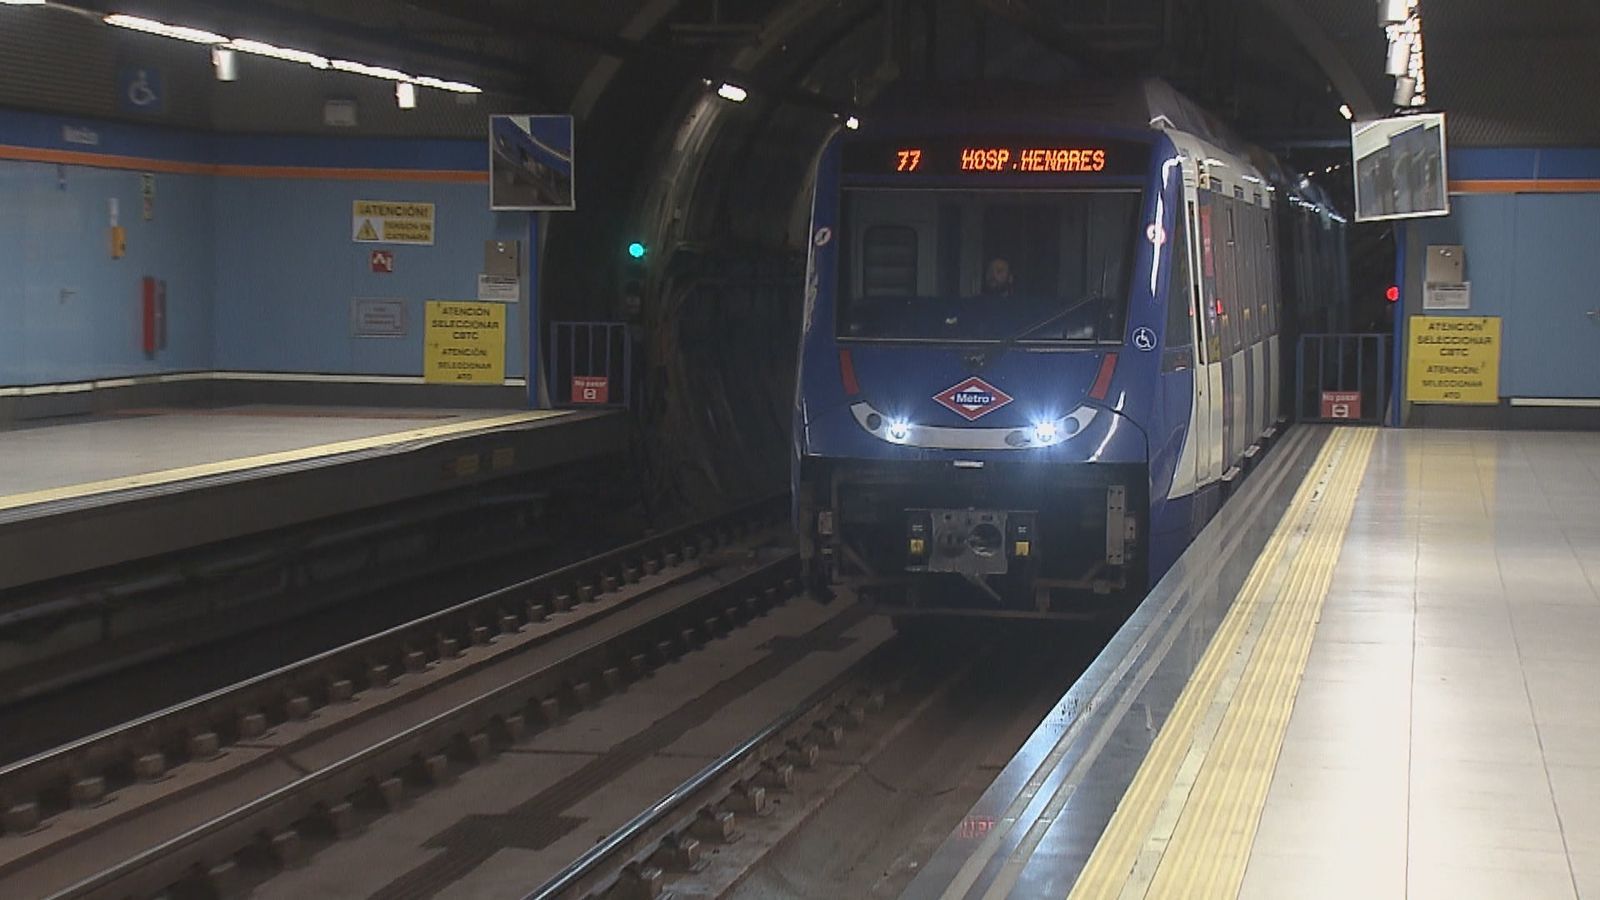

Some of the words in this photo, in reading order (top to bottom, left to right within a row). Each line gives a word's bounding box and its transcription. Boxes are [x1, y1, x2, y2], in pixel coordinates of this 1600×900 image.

[897, 150, 921, 172] 77
[432, 319, 500, 329] SELECCIONAR
[1417, 336, 1492, 345] SELECCIONAR
[955, 393, 990, 404] Metro
[1322, 392, 1334, 401] No
